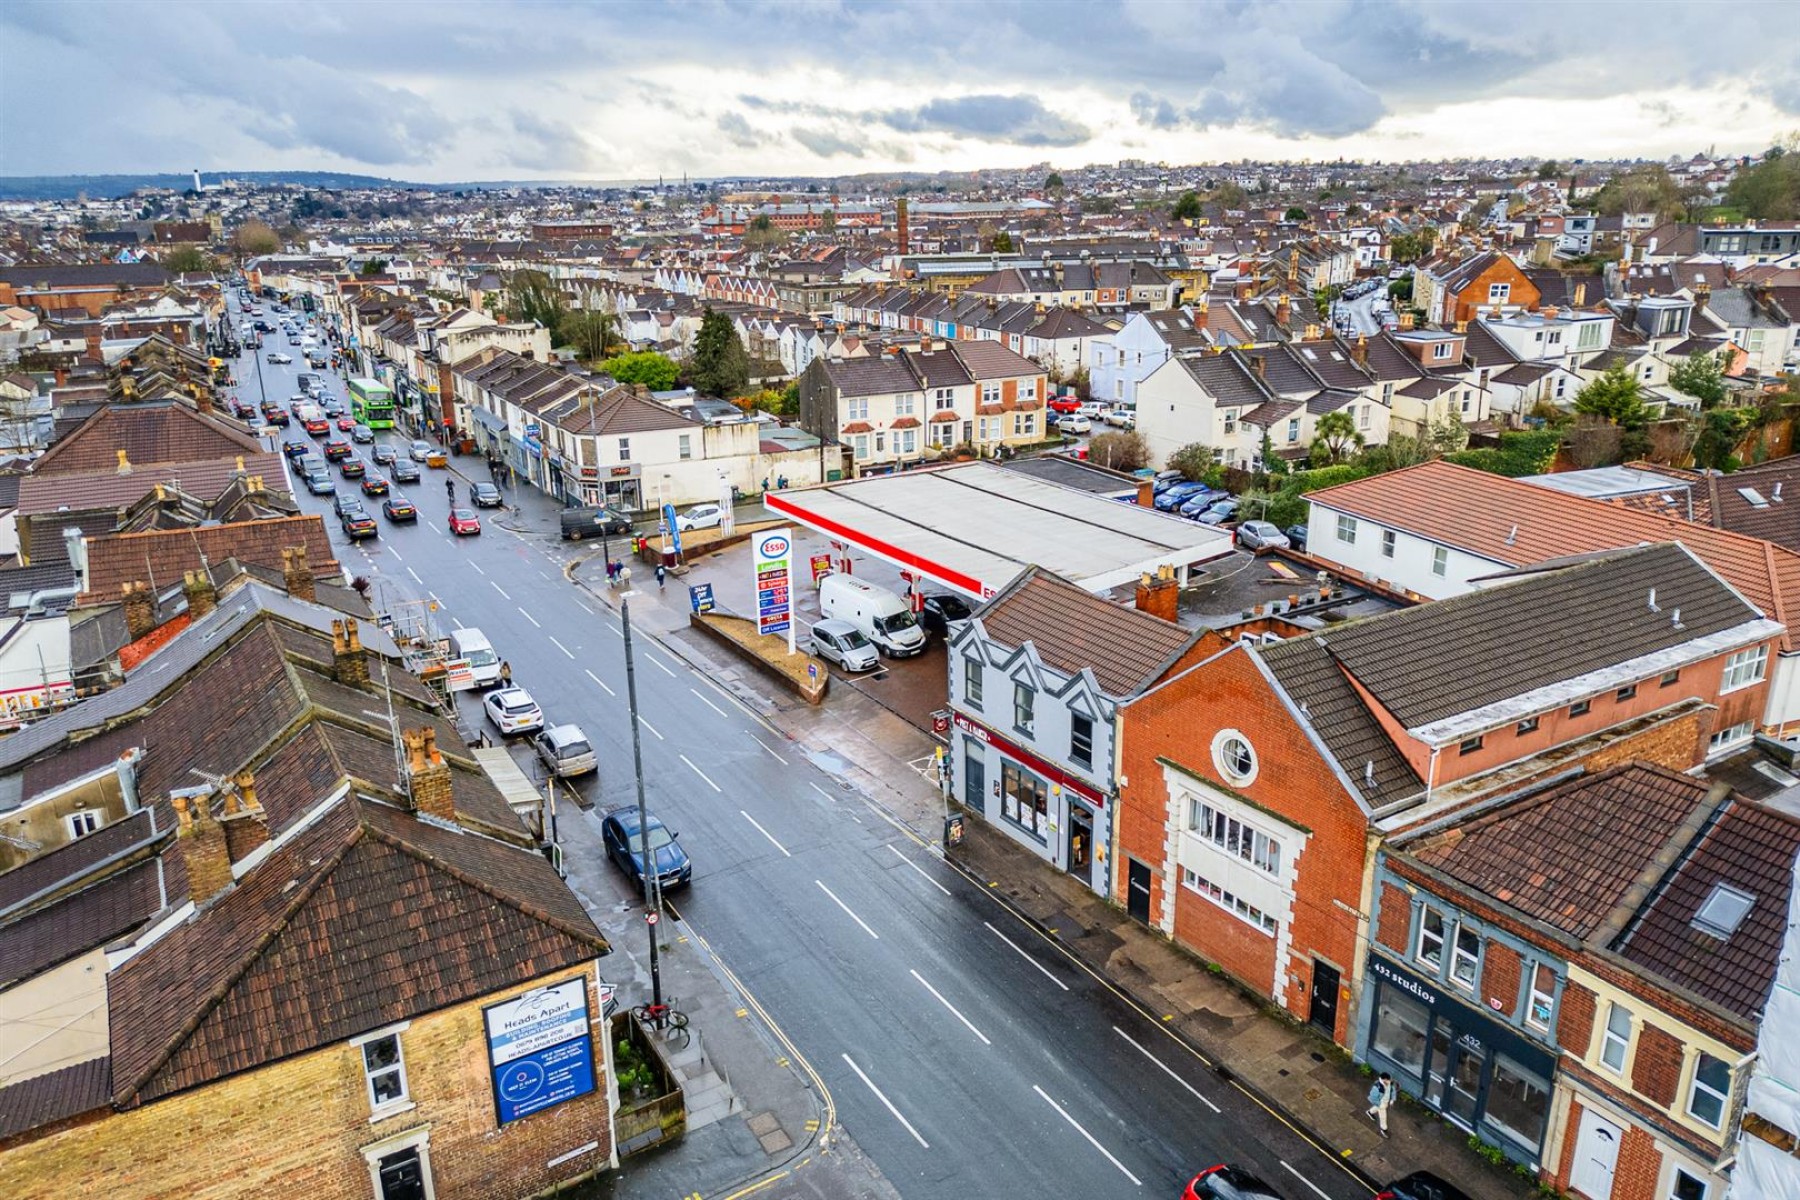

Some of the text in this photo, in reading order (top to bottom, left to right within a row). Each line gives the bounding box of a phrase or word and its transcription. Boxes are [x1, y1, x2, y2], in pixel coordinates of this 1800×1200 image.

[1374, 963, 1435, 1004] 432 studios
[504, 1002, 570, 1029] Heads Apart
[1464, 1034, 1480, 1050] 432
